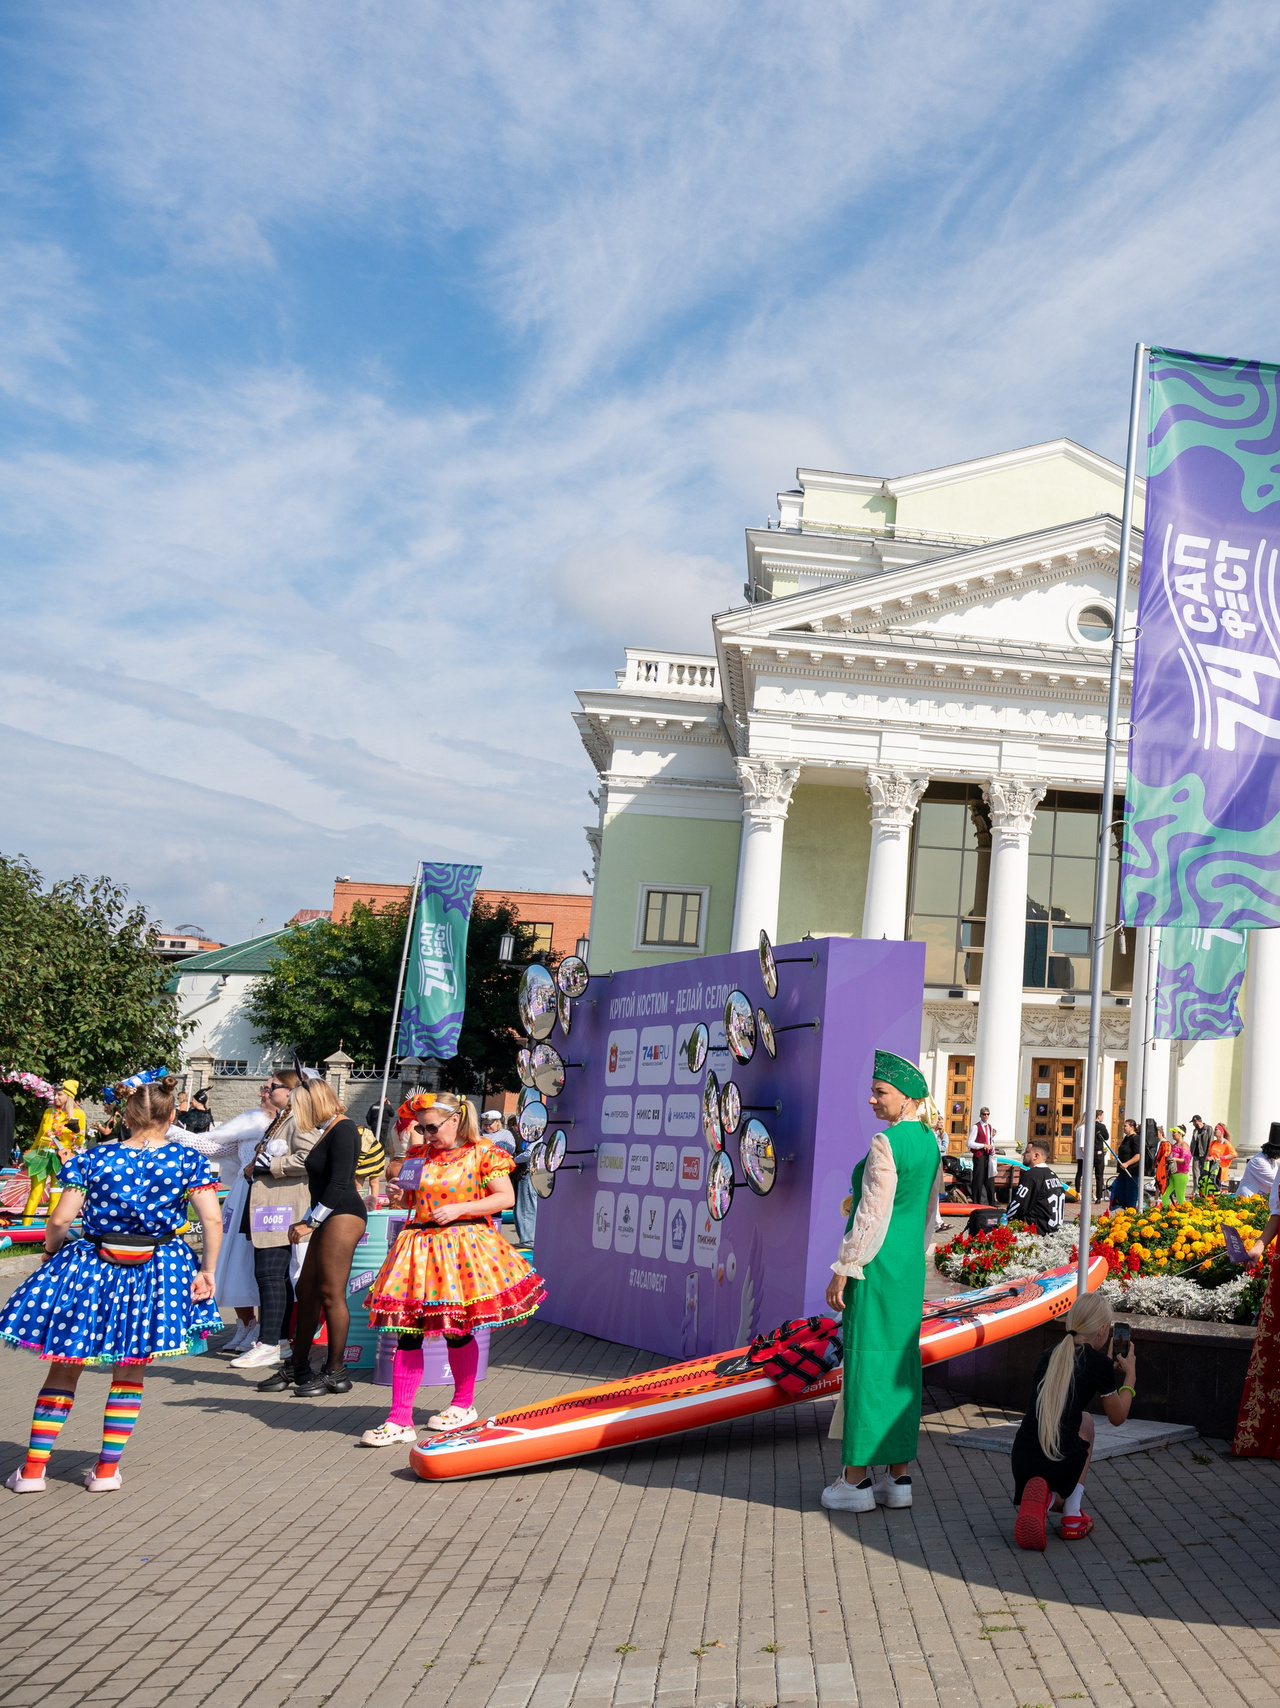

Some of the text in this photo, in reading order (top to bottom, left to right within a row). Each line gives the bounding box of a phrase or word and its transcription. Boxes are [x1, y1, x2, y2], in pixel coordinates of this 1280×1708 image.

[1173, 533, 1218, 633] САП
[775, 685, 825, 707] ЗАЛ
[841, 691, 978, 721] ОРГАННОЙ
[994, 704, 1008, 723] И
[420, 922, 436, 956] САП
[1201, 928, 1243, 951] 7
[423, 960, 455, 997] 74
[609, 991, 636, 1020] КРУТОЙ
[636, 991, 668, 1016] КОСТЮМ
[675, 982, 703, 1015] ДЕЛАЙ
[705, 983, 738, 1009] СЕЛФ
[635, 1109, 652, 1120] НИКС
[672, 1111, 696, 1120] НИАГАРА
[262, 1214, 284, 1225] 0605
[1047, 1192, 1066, 1228] 30
[697, 1234, 718, 1246] ПИКНИК
[350, 1279, 361, 1291] 74
[629, 1268, 668, 1293] #74САПФЕСТ
[802, 1373, 844, 1394] eath-R
